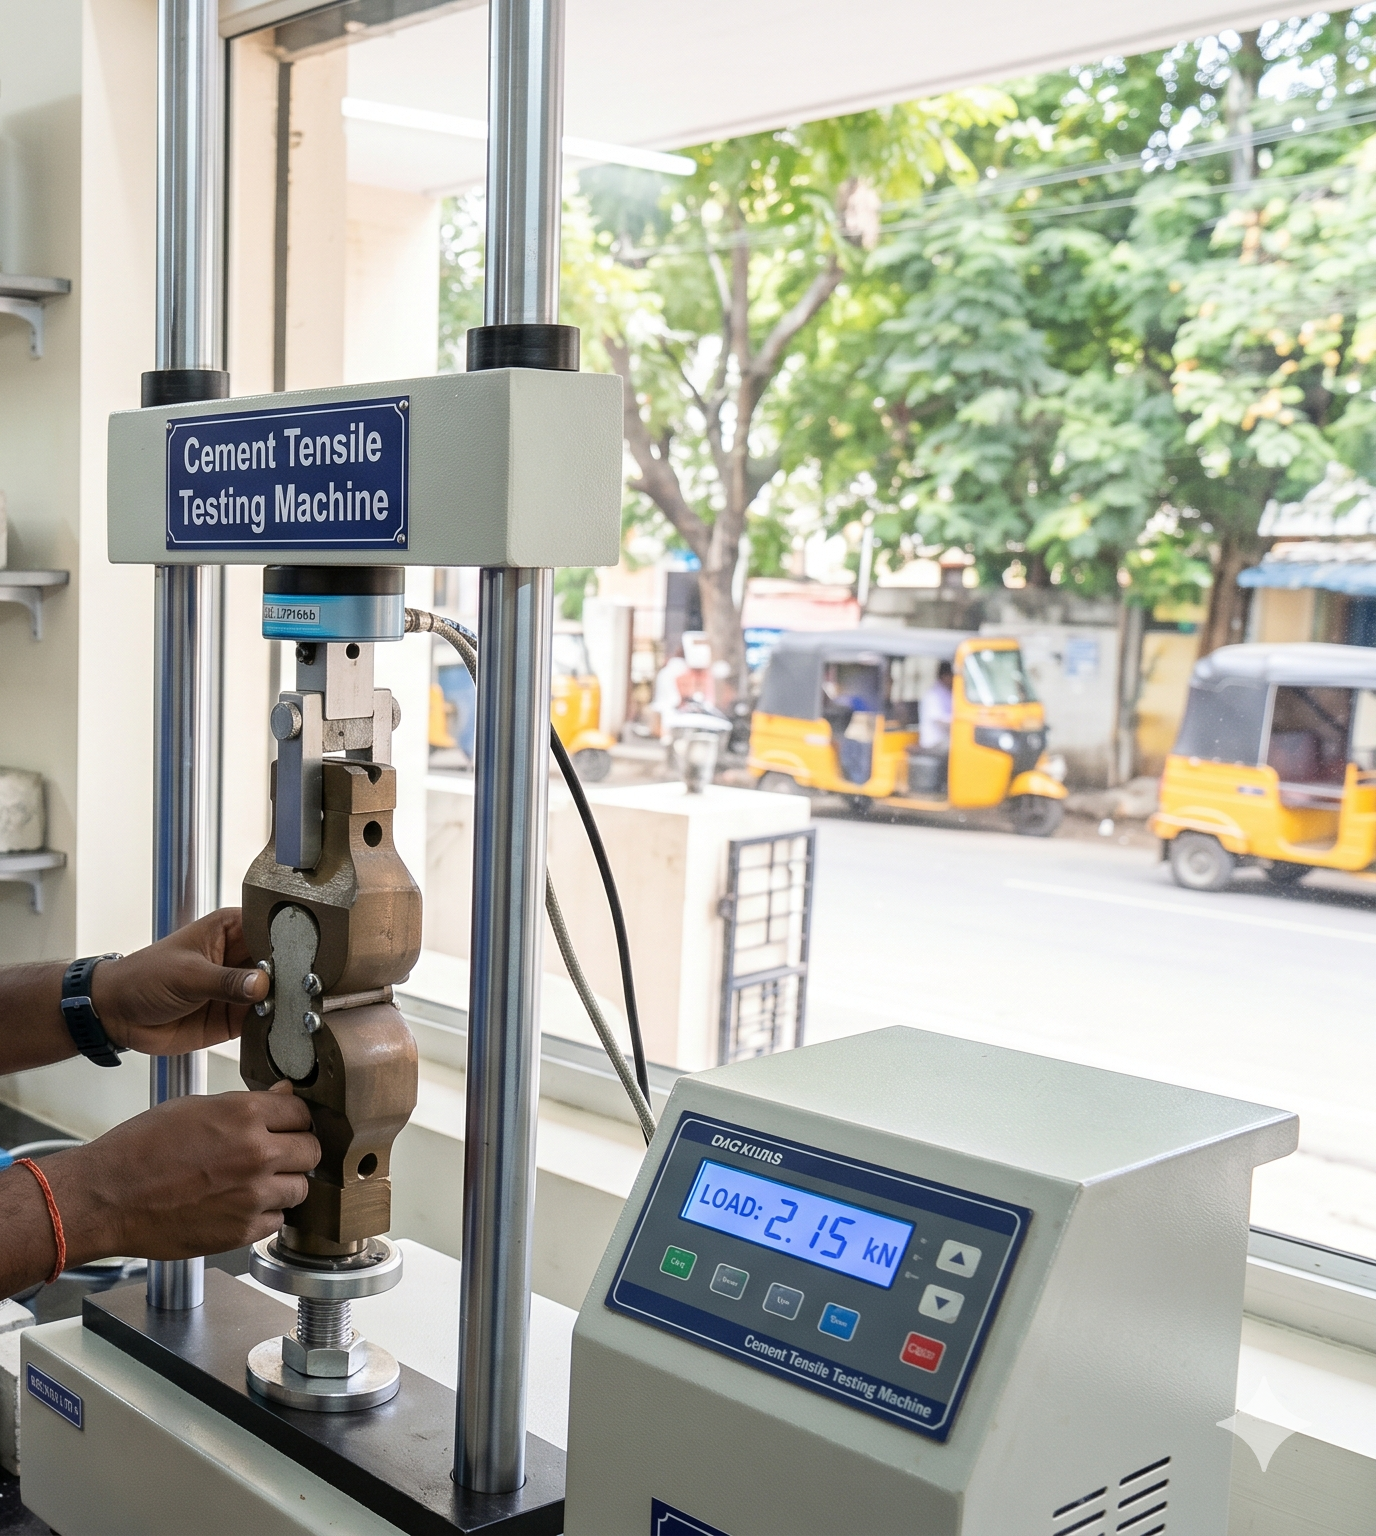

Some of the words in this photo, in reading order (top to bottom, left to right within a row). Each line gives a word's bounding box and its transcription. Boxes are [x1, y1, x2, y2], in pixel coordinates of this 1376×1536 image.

[184, 431, 276, 474] Cement
[284, 421, 383, 467] Tensile
[178, 487, 265, 534] Testing
[275, 480, 389, 523] Machine
[699, 1184, 763, 1220] LOAD:
[764, 1198, 856, 1259] 2.15
[862, 1237, 898, 1268] kN
[744, 1334, 787, 1362] Cement
[788, 1350, 830, 1379] Tensile
[832, 1367, 877, 1400] Testing
[877, 1385, 932, 1419] Machine
